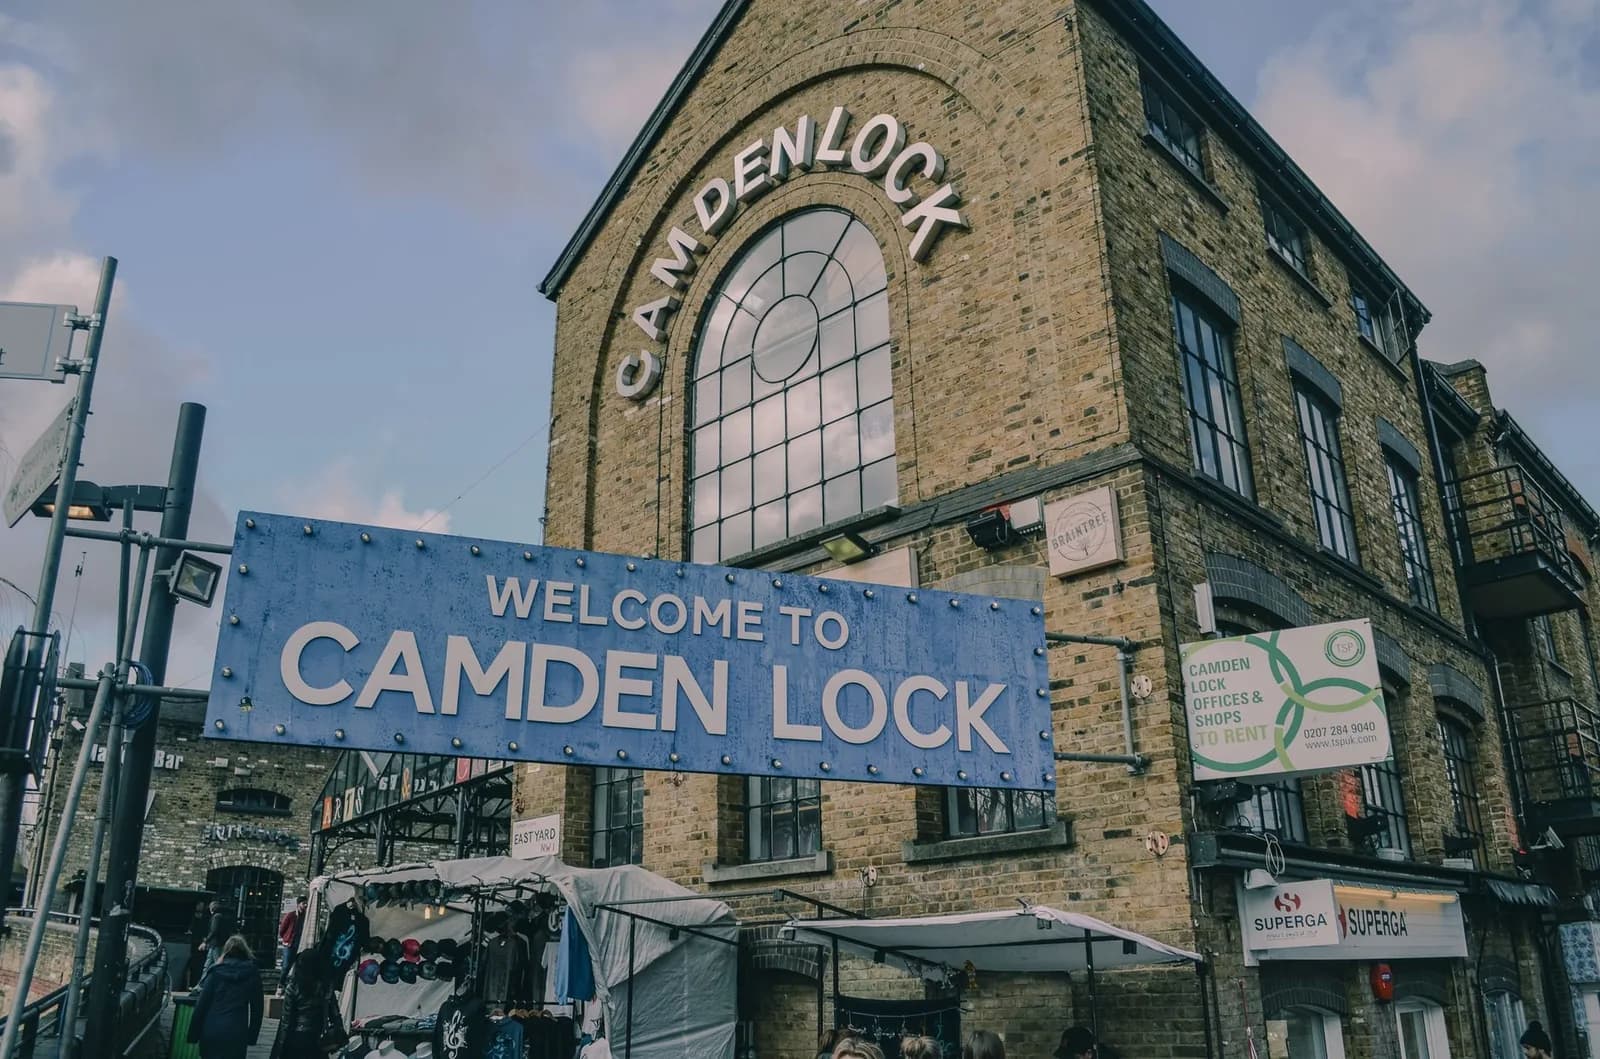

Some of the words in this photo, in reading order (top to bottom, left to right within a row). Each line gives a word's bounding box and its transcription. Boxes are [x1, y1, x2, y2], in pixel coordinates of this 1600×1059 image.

[616, 114, 815, 400] CAMDEN
[815, 106, 968, 263] LOCK
[1052, 511, 1109, 550] BRAINTREE
[486, 574, 764, 642] WELCOME
[779, 606, 849, 651] TO
[1336, 642, 1355, 655] TSP
[1189, 657, 1251, 677] CAMDEN
[280, 620, 729, 736] CAMDEN
[772, 664, 1011, 755] LOCK
[1191, 678, 1227, 694] LOCK
[1193, 692, 1249, 710] OFFICES
[1252, 690, 1264, 704] &
[1195, 710, 1242, 727] SHOPS
[1197, 730, 1219, 746] TO
[1224, 724, 1269, 744] RENT
[1303, 727, 1327, 739] 0207
[1330, 724, 1348, 736] 284
[1351, 721, 1376, 734] 9040
[1304, 734, 1377, 750] www.tspuk.com
[154, 750, 183, 770] Bar
[1254, 913, 1328, 931] SUPERGA
[1348, 907, 1408, 937] SUPERGA
